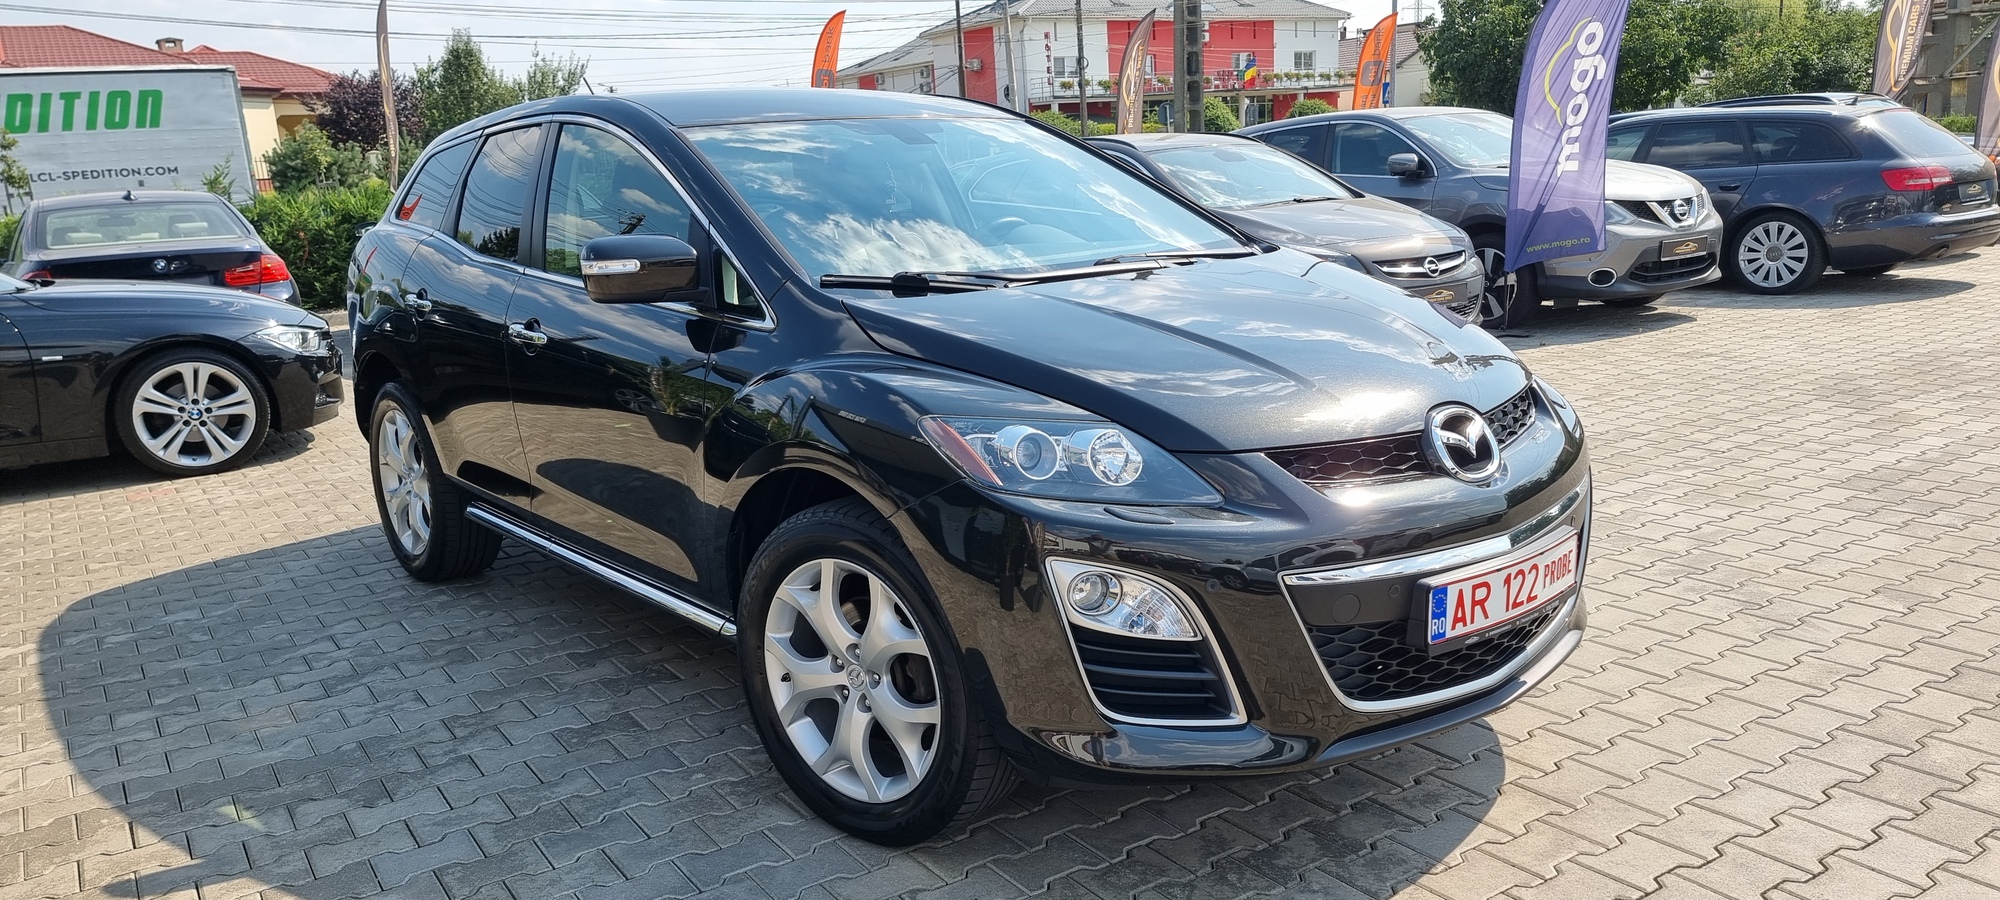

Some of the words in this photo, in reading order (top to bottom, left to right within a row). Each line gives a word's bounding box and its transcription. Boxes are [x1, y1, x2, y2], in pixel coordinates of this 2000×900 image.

[1372, 27, 1384, 56] bank
[1898, 36, 1914, 81] PREMIUM
[1908, 5, 1920, 34] CARS
[1557, 21, 1607, 177] mogo
[1526, 236, 1591, 253] www.mogo.ro
[1451, 581, 1492, 631] AR
[1503, 562, 1539, 613] 122
[1543, 549, 1573, 589] PROBE
[1432, 617, 1446, 636] RO
